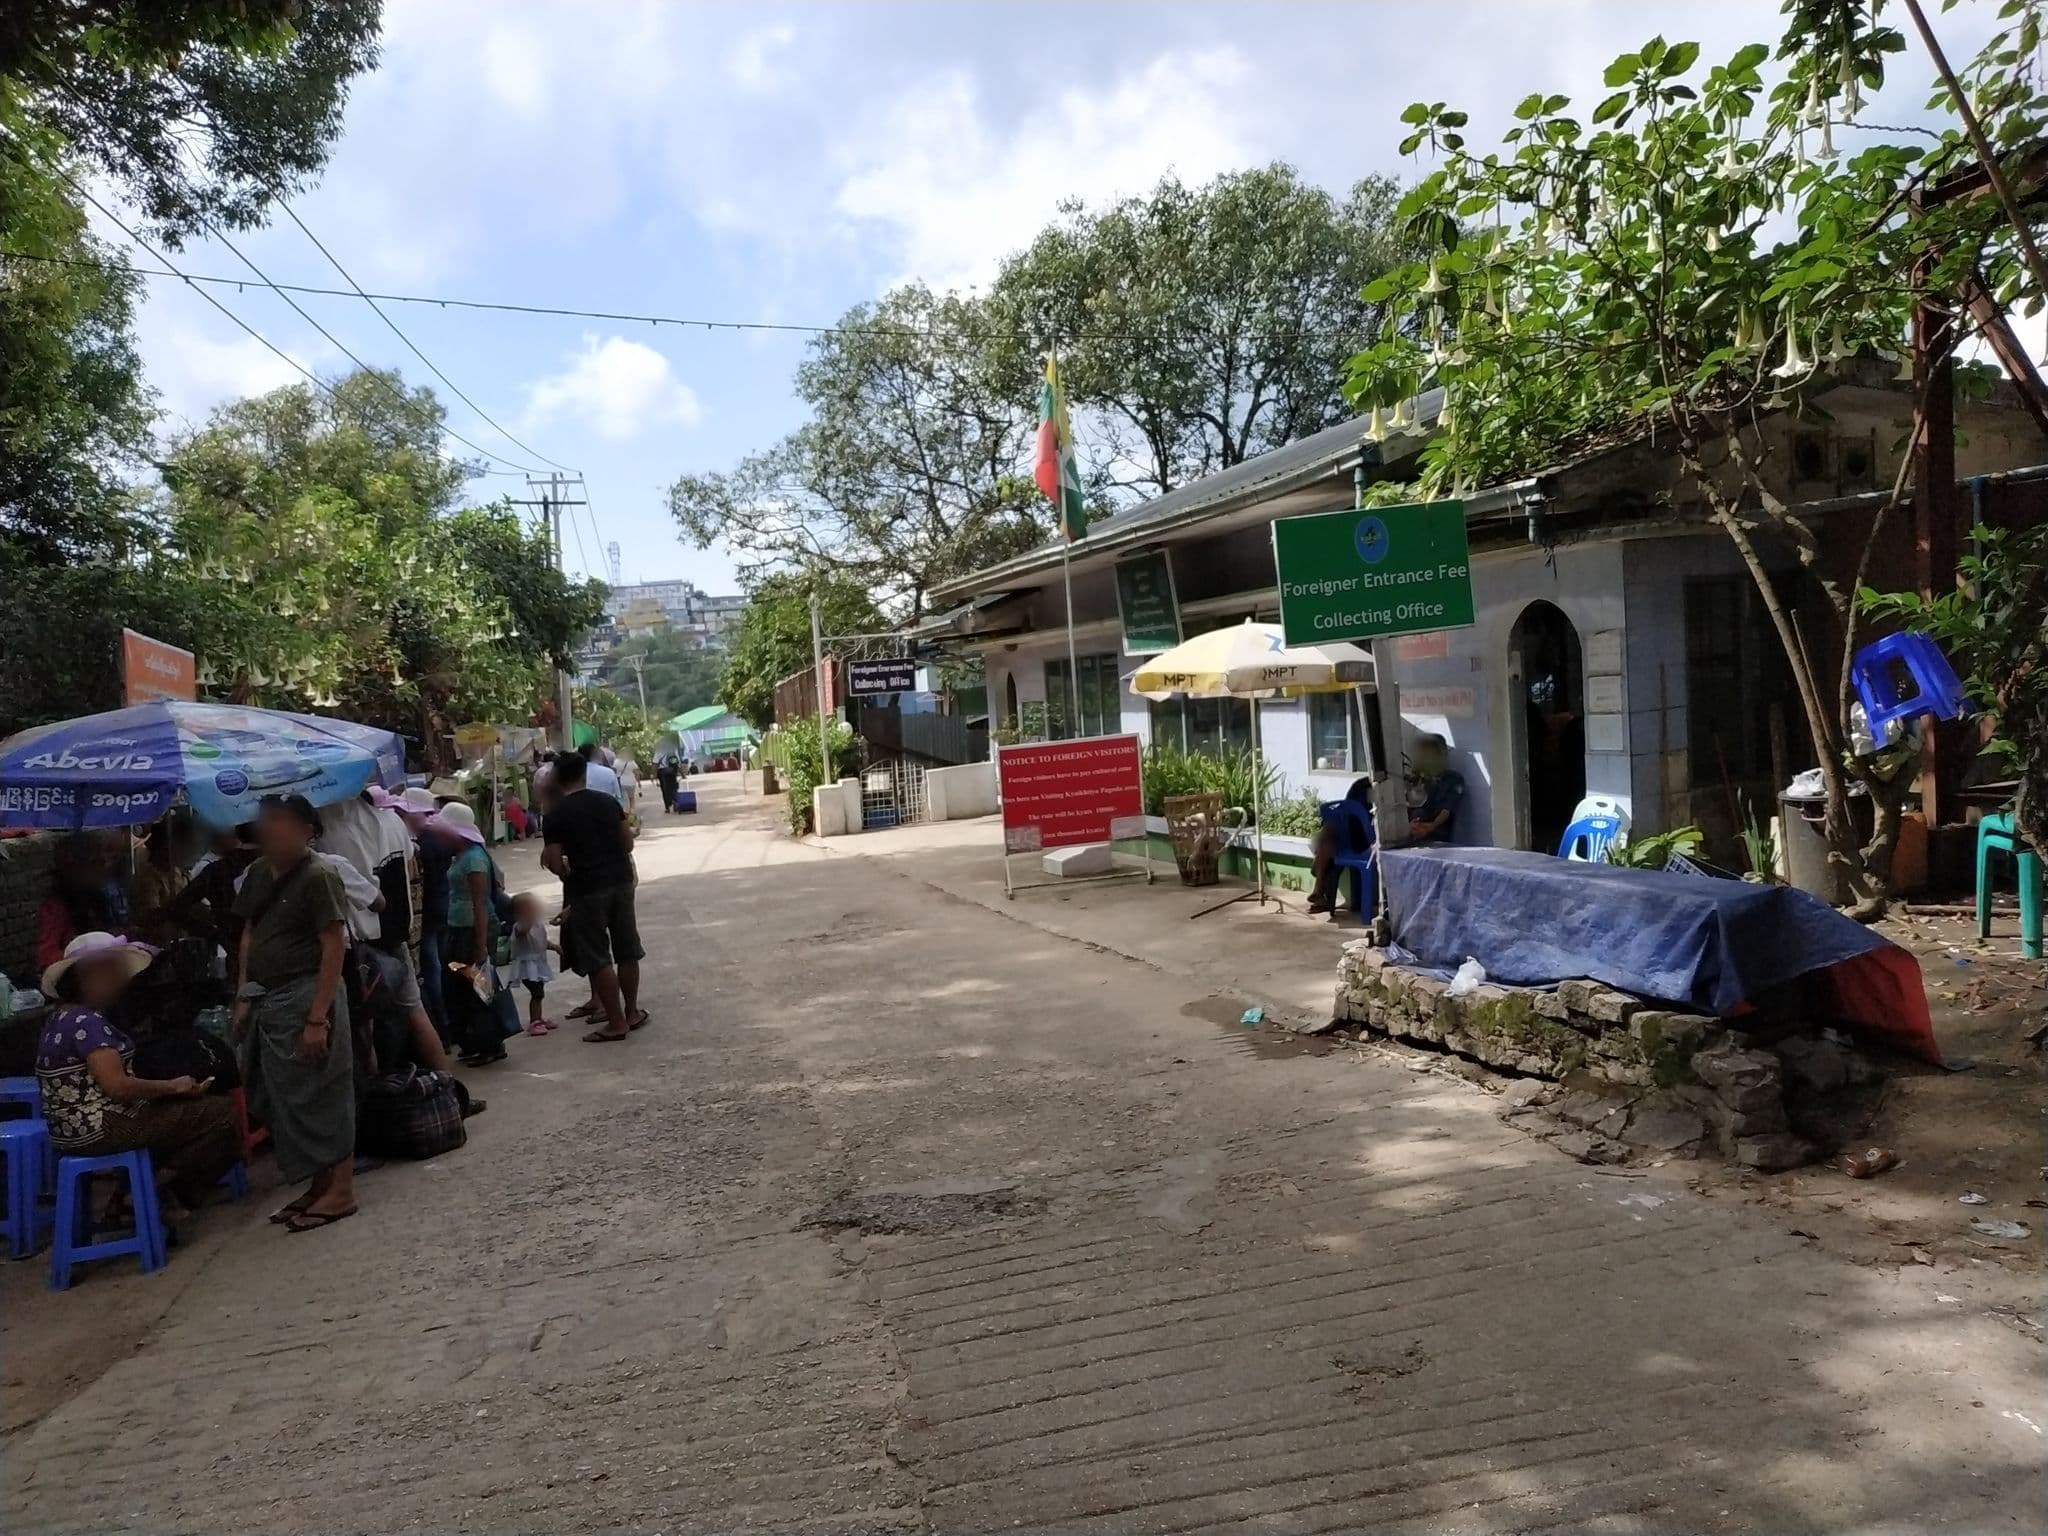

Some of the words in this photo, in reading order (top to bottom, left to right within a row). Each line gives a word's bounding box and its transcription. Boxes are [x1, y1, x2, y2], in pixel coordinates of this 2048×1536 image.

[1283, 577, 1359, 597] Foreigner
[1364, 569, 1434, 588] Entrance
[1438, 563, 1468, 579] Fee
[1313, 608, 1393, 630] Collecting
[1396, 602, 1444, 620] Office
[1163, 673, 1197, 687] MPT
[1268, 666, 1298, 678] MPT
[1002, 757, 1036, 766] NOTICE
[1039, 755, 1051, 763] TO
[1052, 751, 1093, 762] FOREIGN
[1094, 746, 1136, 756] VISITORS
